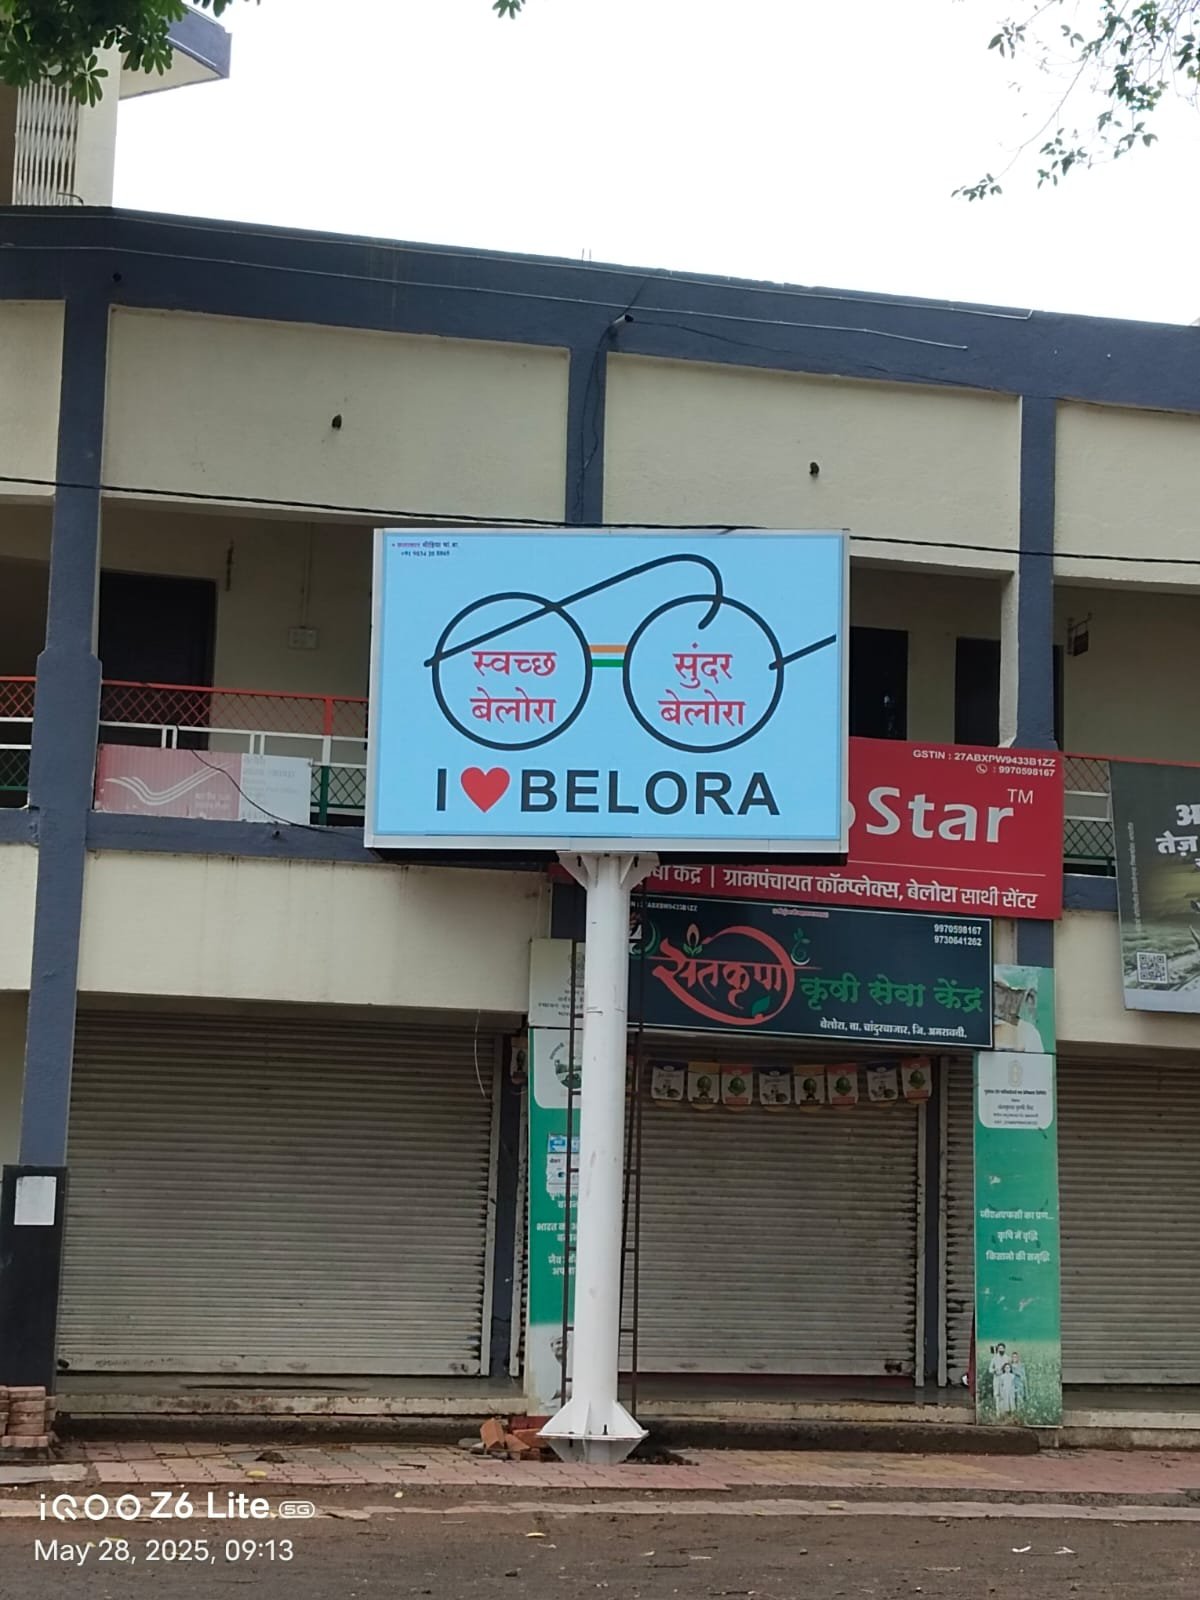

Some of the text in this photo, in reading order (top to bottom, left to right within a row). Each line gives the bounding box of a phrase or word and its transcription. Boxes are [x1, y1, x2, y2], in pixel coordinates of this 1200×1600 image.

[471, 651, 557, 676] स्वच्छ
[673, 643, 733, 689] सुंदर
[469, 687, 557, 724] बेलोरा
[658, 689, 746, 726] बेलोरा
[913, 750, 945, 760] GSTIN
[436, 768, 780, 816] I BELORA
[723, 868, 813, 892] ग्रामपंचायत
[815, 873, 903, 901] कॉम्प्लेक्स,
[906, 878, 959, 903] बेलोरा
[960, 887, 1000, 906] साथी
[1001, 888, 1038, 909] सेंटर
[800, 972, 985, 1013] कृषी सेवा केंद्र
